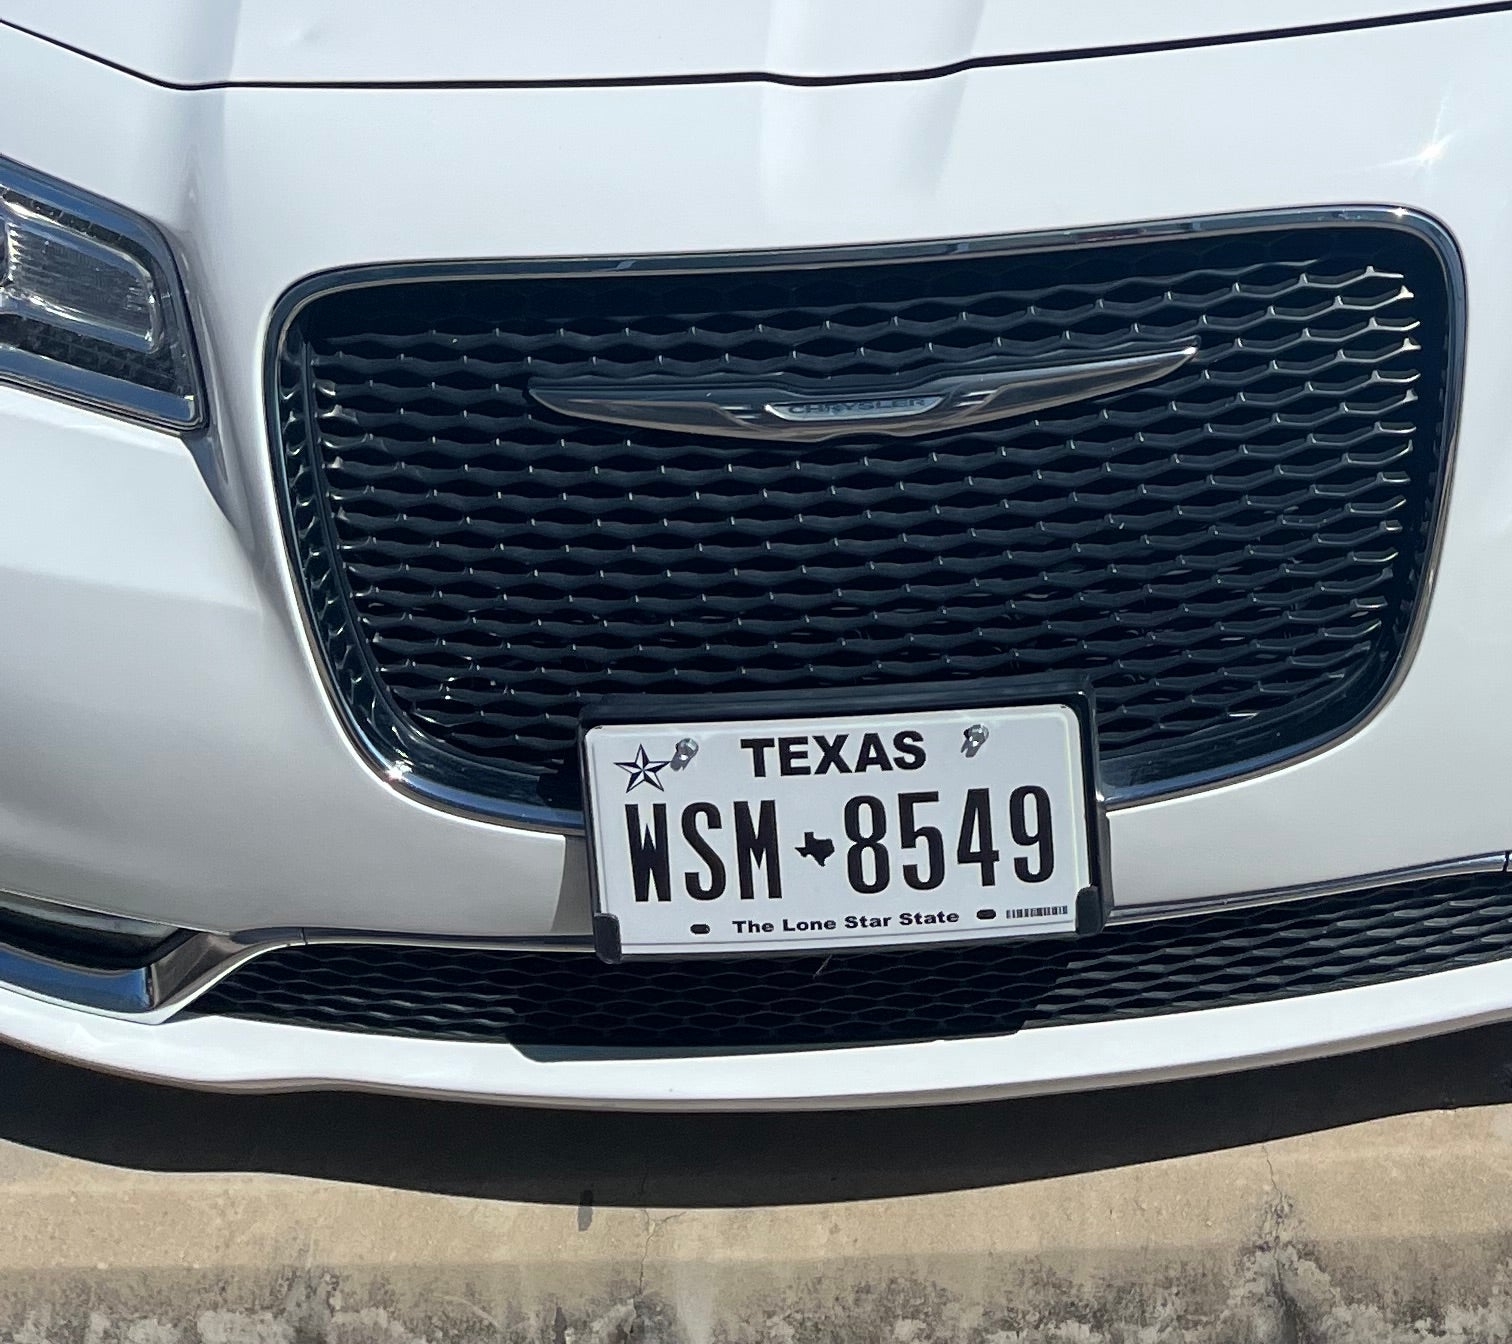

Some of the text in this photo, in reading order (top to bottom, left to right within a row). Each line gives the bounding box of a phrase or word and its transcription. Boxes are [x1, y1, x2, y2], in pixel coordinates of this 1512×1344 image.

[788, 398, 926, 415] CHRYSLER
[741, 730, 927, 778] TEXAS
[624, 785, 1055, 903] WSM 8549
[732, 910, 960, 935] The Lone Star State
